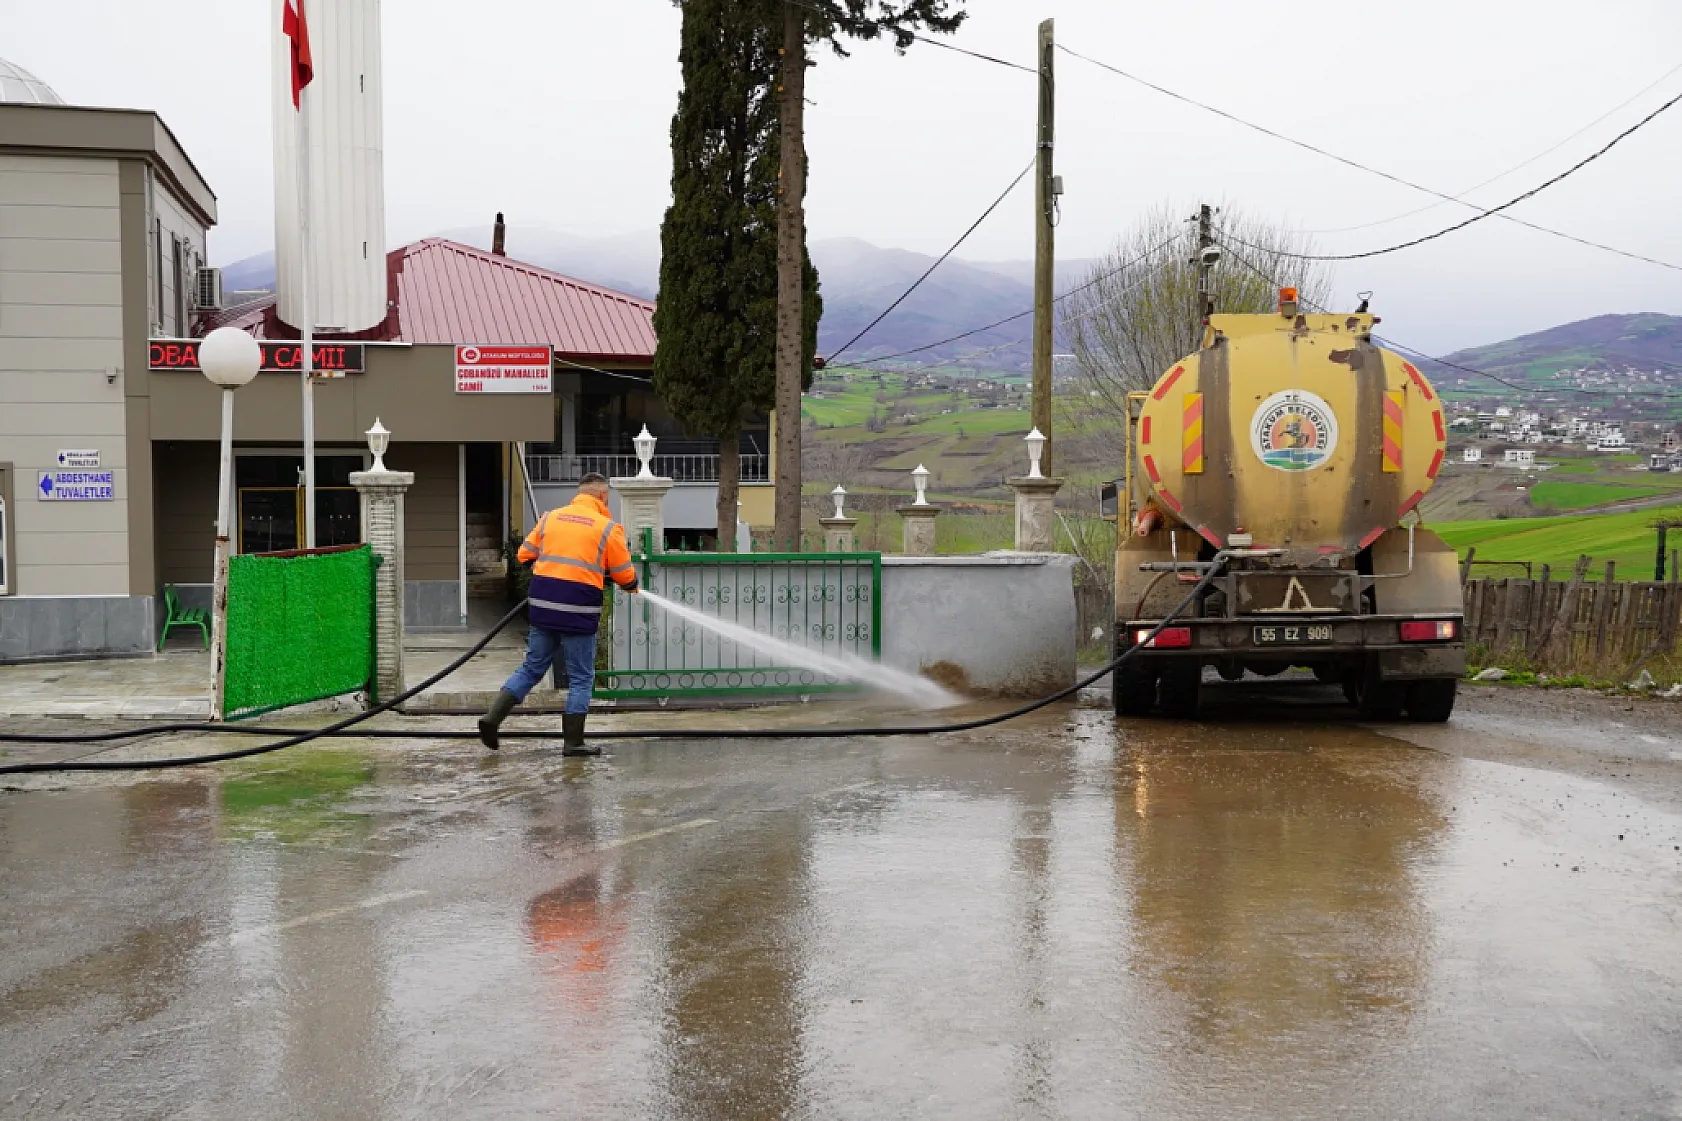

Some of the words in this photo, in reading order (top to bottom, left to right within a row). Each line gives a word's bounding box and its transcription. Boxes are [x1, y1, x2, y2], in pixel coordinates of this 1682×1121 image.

[56, 473, 112, 482] ABDESTHANE
[56, 486, 112, 498] TUVALETLER
[1262, 628, 1275, 641] 55
[1285, 627, 1299, 640] EZ
